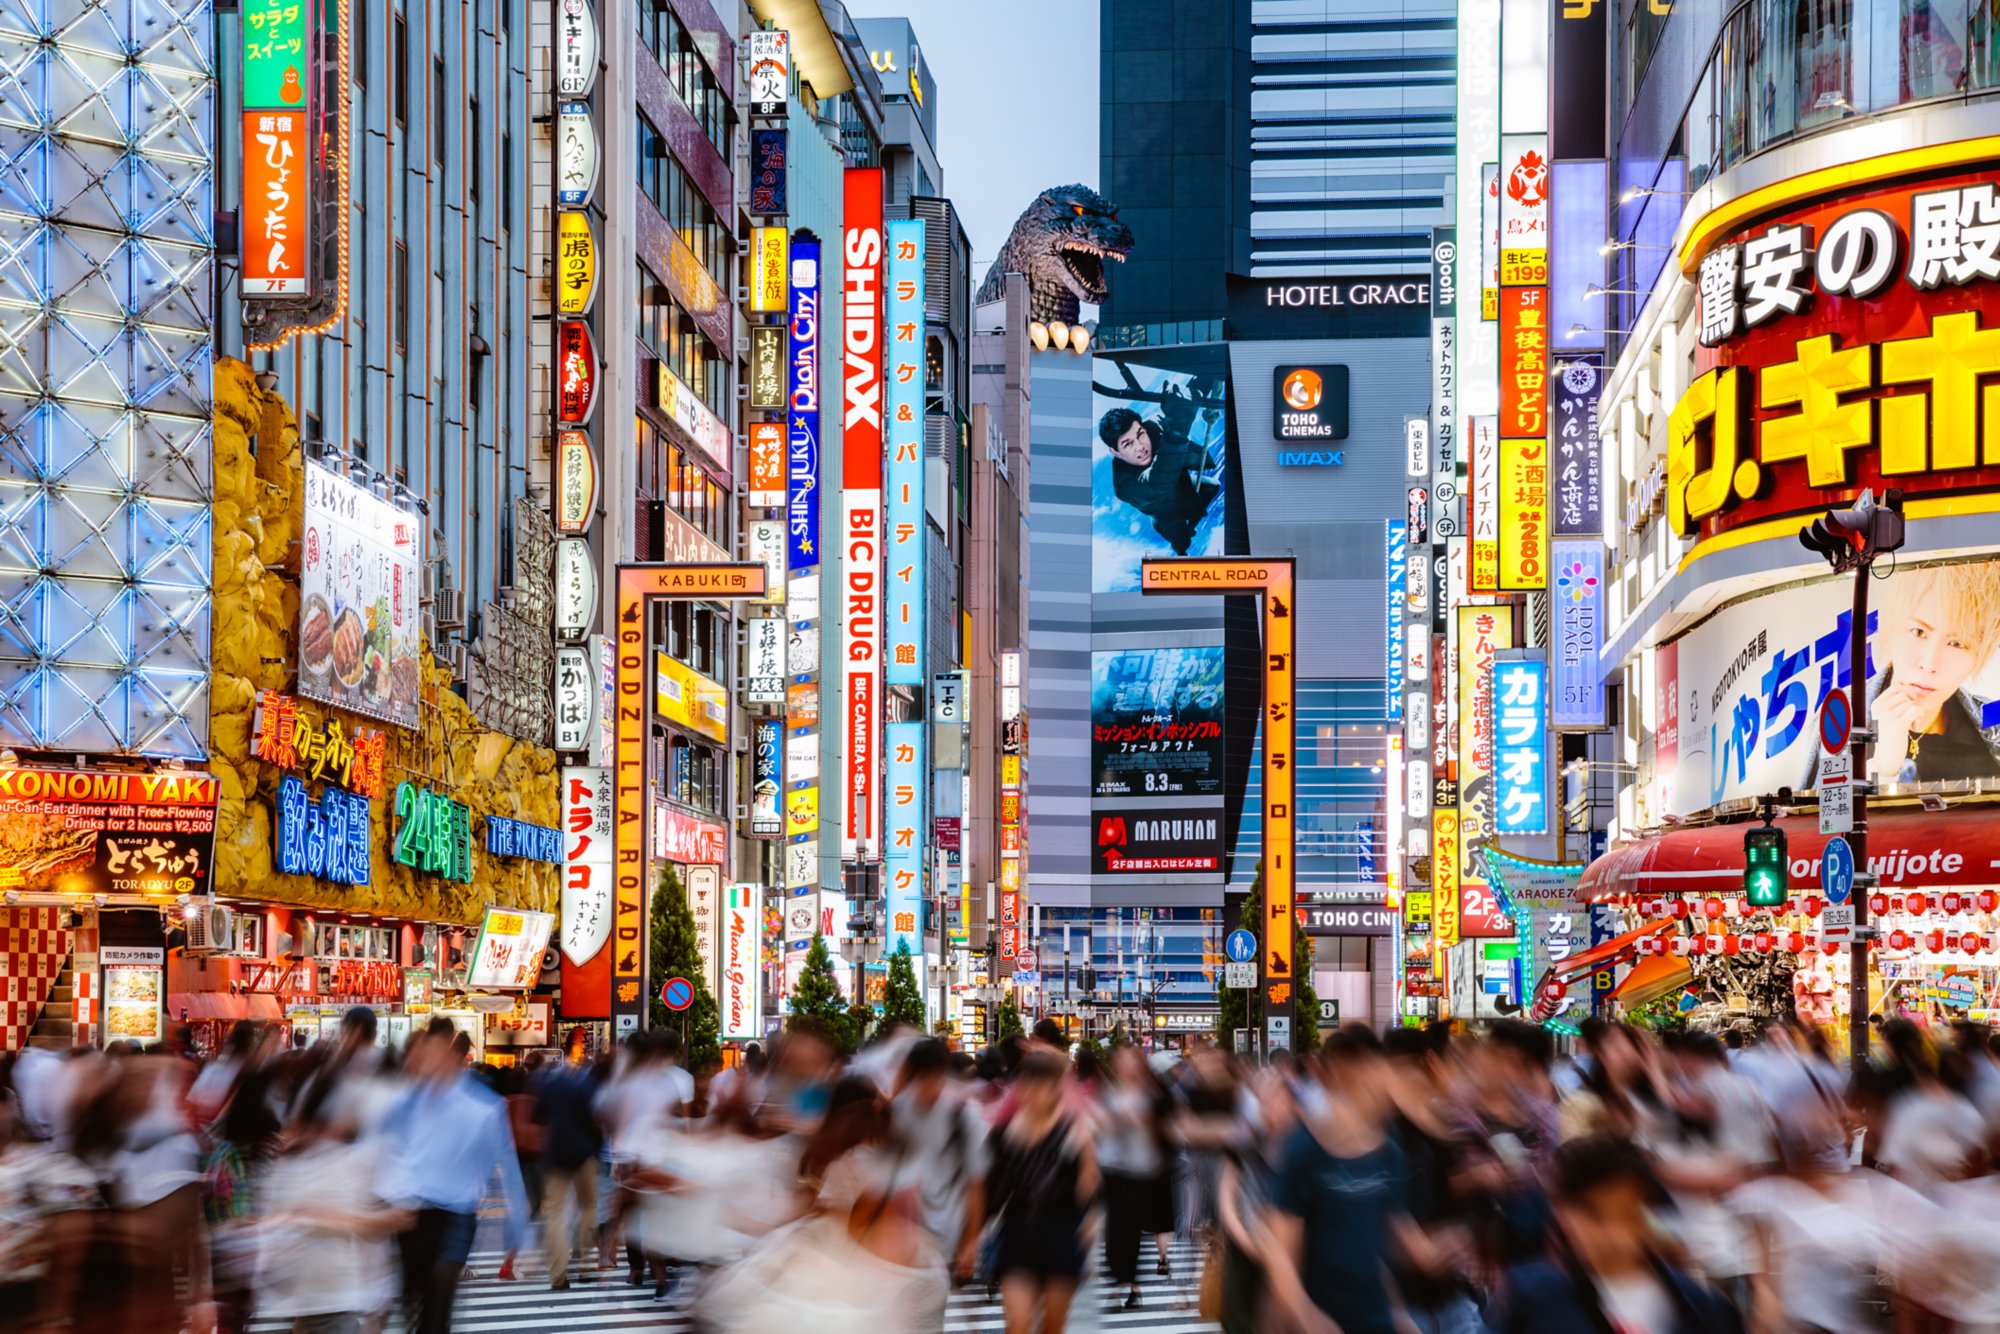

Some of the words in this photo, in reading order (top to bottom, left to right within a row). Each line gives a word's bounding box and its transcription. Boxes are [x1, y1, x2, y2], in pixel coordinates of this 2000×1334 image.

[248, 5, 299, 30] サラダ
[247, 38, 302, 61] スイーツ
[753, 34, 774, 45] 海鮮
[753, 45, 784, 55] 居酒屋
[561, 78, 585, 91] 6F
[761, 103, 776, 113] 8F
[259, 116, 293, 133] 新宿
[256, 134, 294, 274] ひょうたん
[565, 192, 581, 202] 5F
[563, 240, 590, 290] 虎の子
[1513, 265, 1546, 281] 199
[1700, 182, 2000, 347] 驚安の殿
[266, 280, 286, 292] 7F
[1266, 286, 1344, 307] HOTEL
[1520, 290, 1540, 306] 5F
[561, 298, 581, 309] 4F
[845, 227, 882, 432] SHIDAX
[757, 330, 780, 397] 山内農場
[1439, 326, 1452, 399] ネットカフェ
[1514, 309, 1546, 433] 豊後高田どり
[662, 373, 673, 409] 3F
[762, 397, 774, 405] 5F
[1282, 413, 1318, 426] TOHO
[1282, 426, 1332, 437] CINEMAS
[1278, 451, 1344, 466] IMAX
[1412, 430, 1423, 472] 東京ビル
[1561, 398, 1584, 525] かんかん商店
[567, 448, 582, 520] お好み焼き
[1514, 464, 1547, 507] 酒場
[1518, 512, 1541, 522] 全品
[849, 508, 874, 563] BIC
[1520, 522, 1539, 577] 280
[1149, 570, 1221, 582] CENTRAL
[1226, 569, 1268, 581] ROAD
[568, 560, 583, 624] とらそば
[848, 572, 874, 662] DRUG
[562, 629, 580, 639] 1F
[1564, 606, 1579, 666] STAGE
[1579, 607, 1594, 657] IDOL
[561, 657, 582, 667] 新宿
[1092, 649, 1212, 682] 不可能が
[560, 668, 583, 724] かっぱ
[854, 677, 867, 701] BIC
[1564, 685, 1593, 704] 5F
[562, 731, 580, 742] B1
[621, 629, 641, 825] GODZILLA
[854, 703, 867, 765] CAMERA
[757, 725, 776, 776] 海の家
[1120, 741, 1195, 753] フォールアウト
[1501, 667, 1541, 827] カラオケ
[142, 776, 216, 803] YAKI
[1145, 774, 1169, 791] 8.3
[1269, 653, 1290, 919] ゴジラロード
[1436, 780, 1457, 792] 4F
[67, 804, 107, 817] dinner
[109, 806, 135, 818] with
[137, 806, 214, 820] Free-Flowing
[596, 771, 612, 836] 大衆酒場
[1436, 793, 1457, 805] 3F
[65, 817, 104, 830] Drinks
[107, 818, 125, 830] for
[127, 819, 135, 831] 2
[137, 819, 173, 832] hours
[175, 820, 213, 833] ¥2,500
[280, 776, 370, 886] 飲み放題
[397, 780, 472, 885] 24時間
[490, 816, 514, 855] THE
[568, 778, 593, 890] トラノコ
[894, 743, 915, 933] カラオケ館
[1135, 819, 1217, 841] MARUHAN
[106, 838, 200, 875] とらぢゅう
[112, 879, 174, 891] TORADYU
[178, 880, 193, 890] 2F
[1827, 852, 1840, 895] P
[618, 849, 640, 942] ROAD
[1463, 889, 1495, 917] 2F
[1313, 911, 1358, 926] TOHO
[104, 950, 161, 961] 防犯カメラ作動中
[337, 960, 399, 996] カラオケBOX
[501, 1020, 544, 1032] トラノコ
